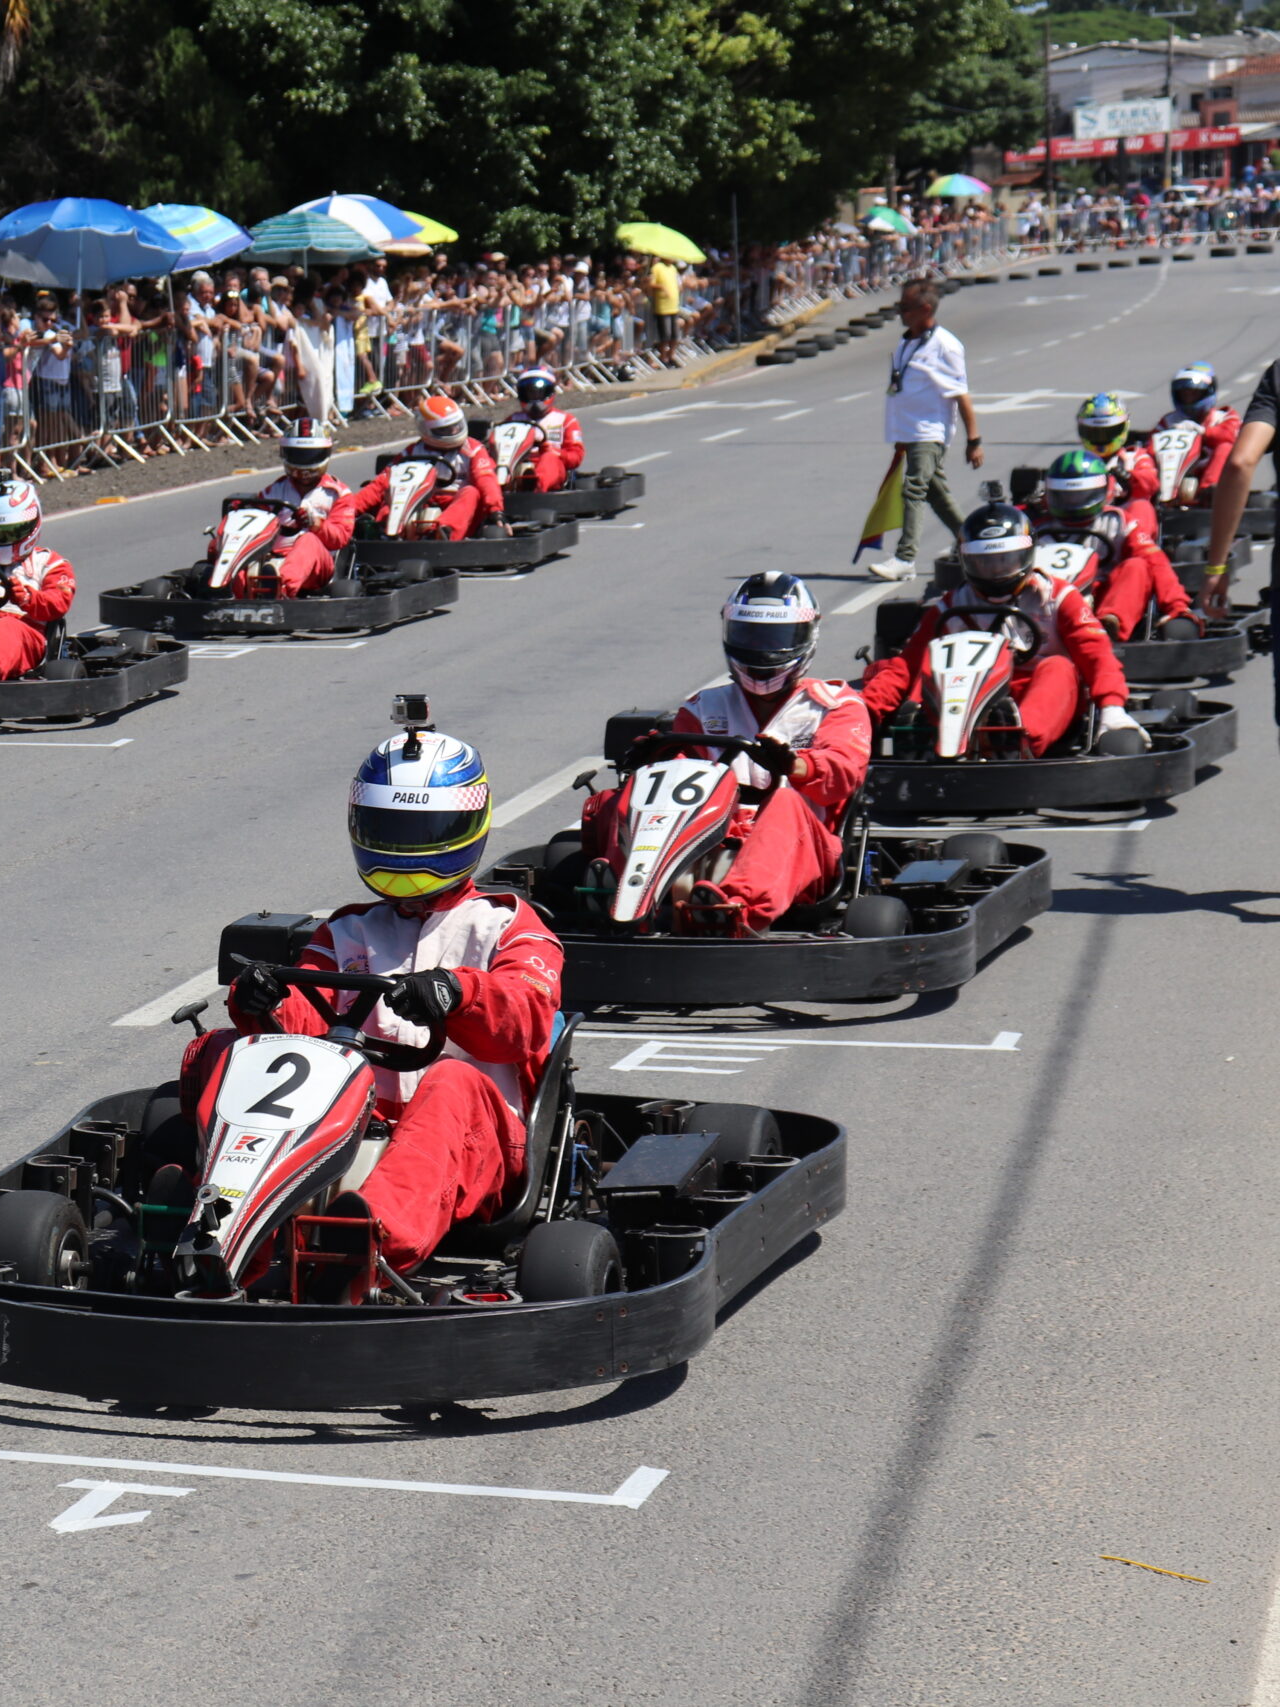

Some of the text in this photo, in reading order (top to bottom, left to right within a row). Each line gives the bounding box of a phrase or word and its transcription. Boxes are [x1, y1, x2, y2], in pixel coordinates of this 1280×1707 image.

[503, 426, 516, 439] 4
[1159, 435, 1188, 452] 25
[400, 466, 418, 483] 5
[239, 514, 257, 531] 7
[1051, 548, 1072, 570] 3
[941, 640, 993, 669] 17
[644, 770, 709, 806] 16
[391, 791, 430, 805] PABLO
[261, 1033, 340, 1051] www.fkart.com.br
[244, 1052, 312, 1120] 2
[219, 1154, 258, 1165] FKART
